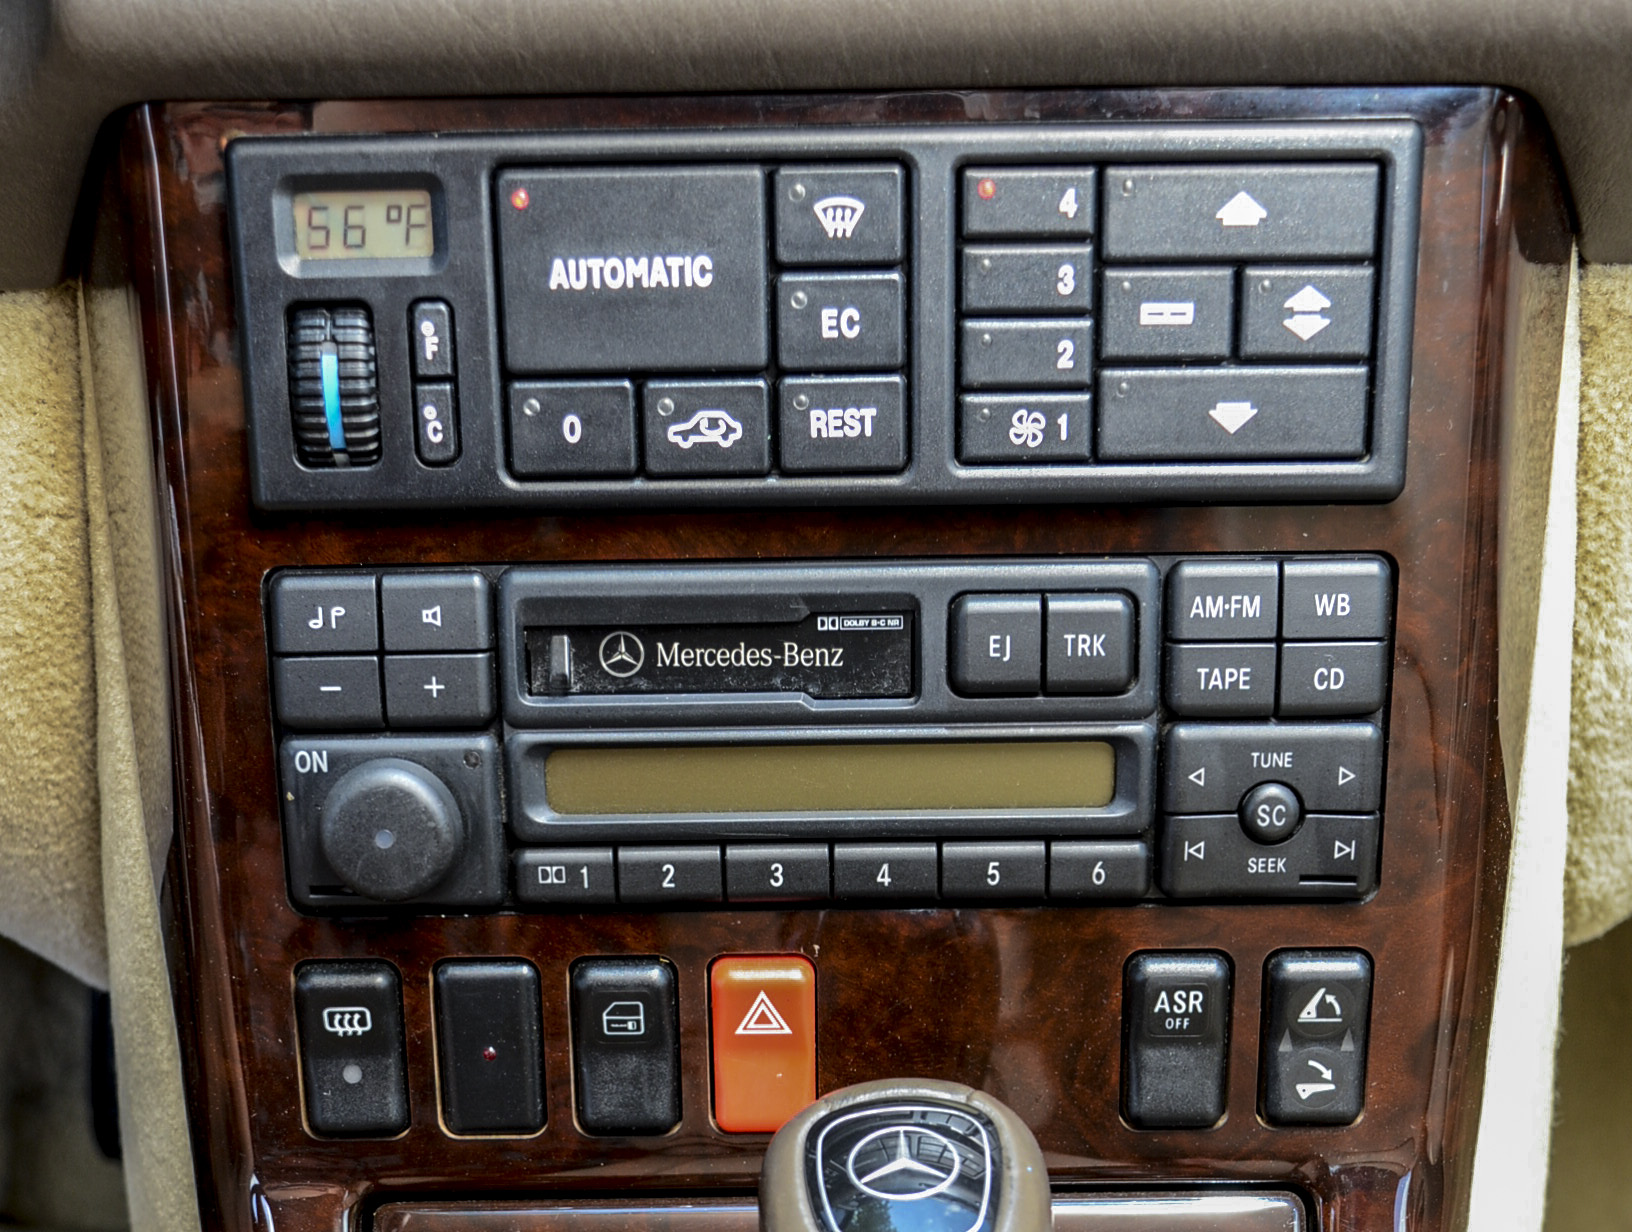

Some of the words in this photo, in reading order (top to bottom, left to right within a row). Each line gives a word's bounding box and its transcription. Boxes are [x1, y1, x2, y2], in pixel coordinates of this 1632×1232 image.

[1058, 187, 1079, 219] 4
[305, 203, 368, 251] 56
[548, 254, 714, 291] AUTOMATIC
[1057, 264, 1076, 296] 3
[820, 306, 861, 339] EC
[1056, 339, 1075, 369] 2
[809, 408, 878, 439] REST
[1056, 412, 1068, 441] 1
[1313, 593, 1352, 617] WB
[843, 619, 869, 627] DOLBY
[656, 641, 844, 667] Mercedes-Benz
[989, 634, 1011, 662] EJ
[1063, 633, 1107, 657] TRK
[1196, 667, 1252, 691] TAPE
[1313, 668, 1346, 691] CD
[294, 749, 328, 773] ON
[1250, 751, 1294, 769] TUNE
[1256, 804, 1288, 828] SC
[580, 865, 589, 889] 1
[662, 863, 676, 888] 2
[769, 862, 784, 888] 3
[876, 863, 892, 887] 4
[986, 861, 1000, 886] 5
[1092, 860, 1106, 885] 6
[1247, 857, 1287, 874] SEEK
[1153, 990, 1203, 1014] ASR
[1165, 1017, 1190, 1030] OFF
